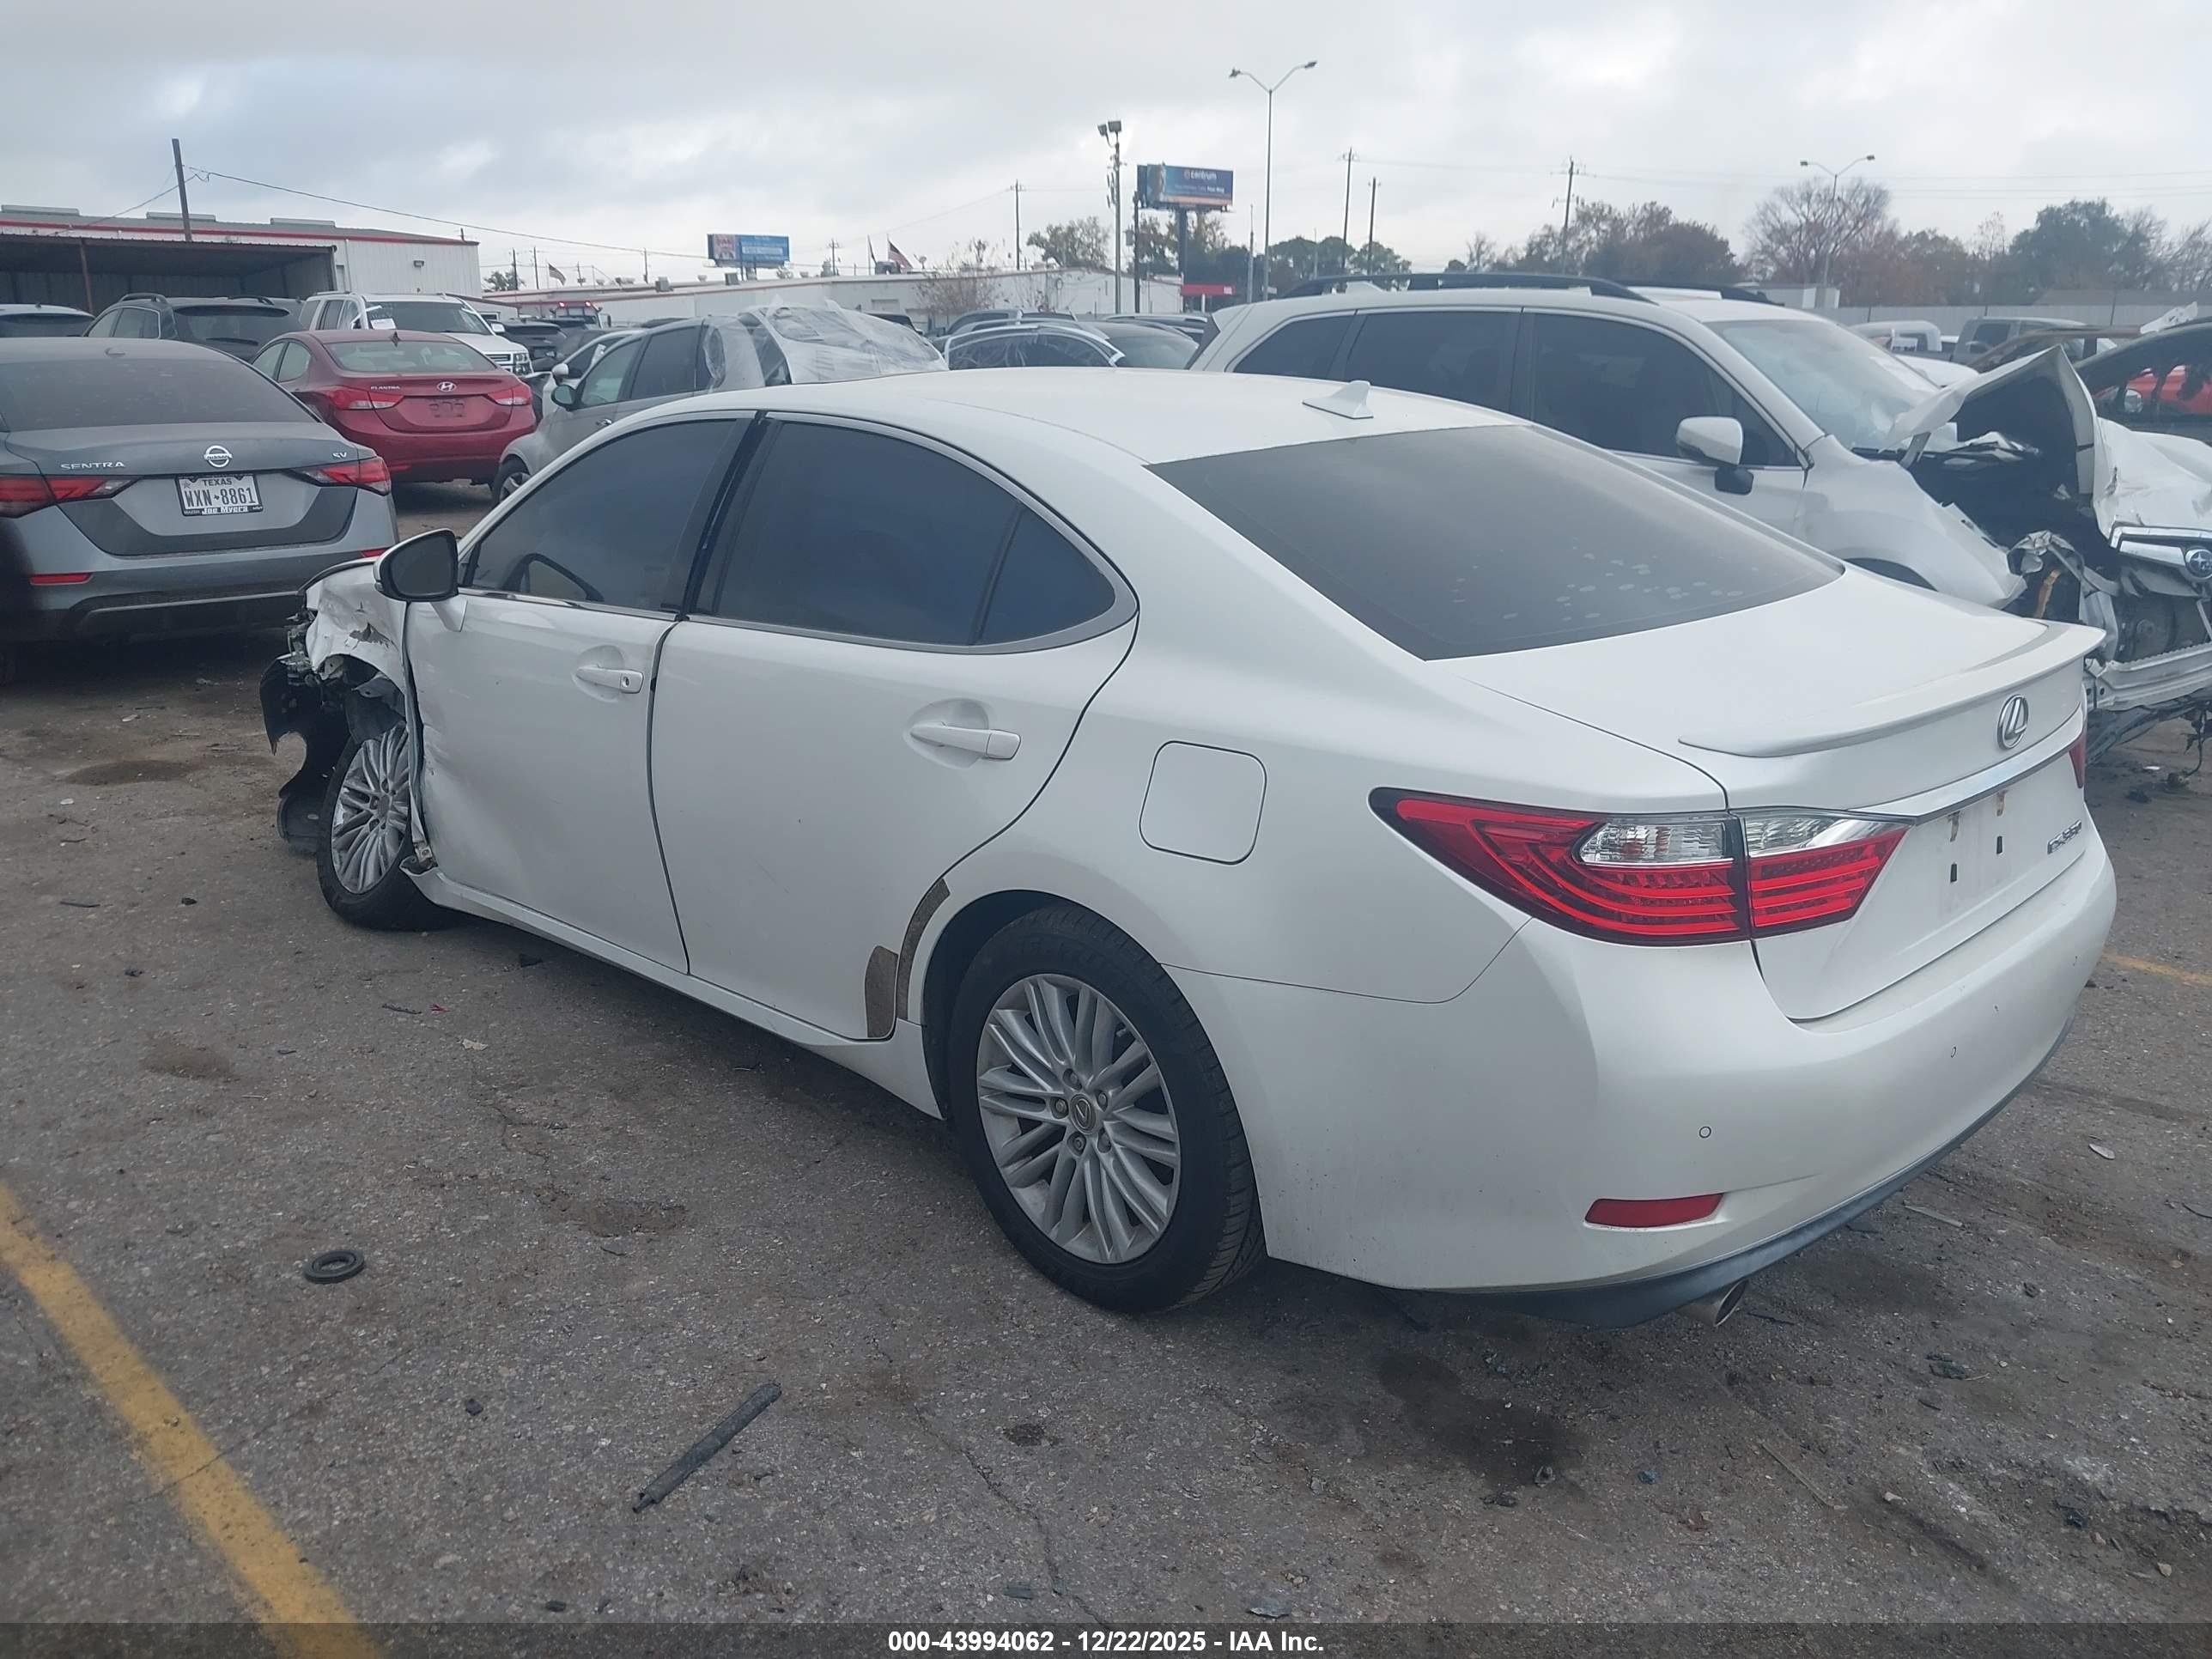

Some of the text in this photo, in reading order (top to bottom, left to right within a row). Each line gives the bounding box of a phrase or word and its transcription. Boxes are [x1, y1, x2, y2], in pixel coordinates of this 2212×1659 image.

[60, 461, 126, 470] SENTRA
[203, 477, 233, 487] TEXAS
[184, 487, 256, 507] WXN 8861
